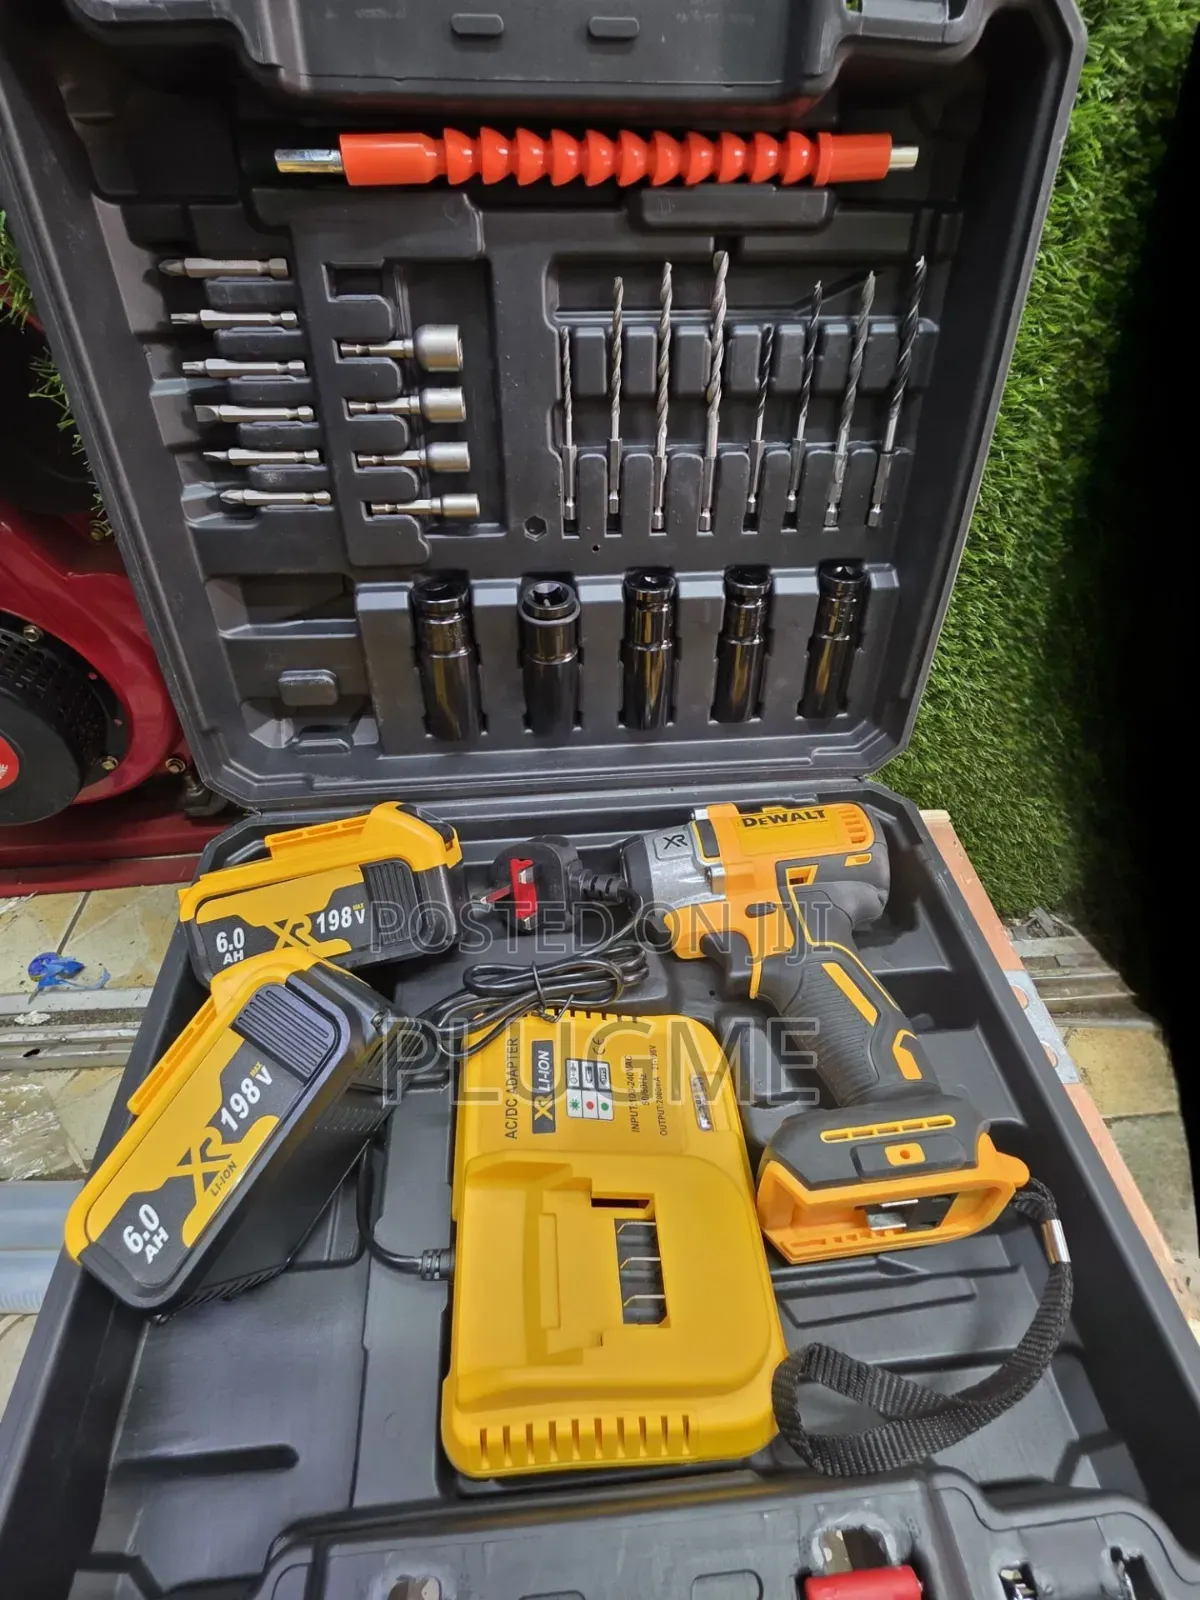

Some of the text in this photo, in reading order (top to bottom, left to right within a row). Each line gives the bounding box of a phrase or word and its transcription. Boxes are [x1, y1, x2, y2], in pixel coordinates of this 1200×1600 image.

[663, 834, 688, 850] XR
[265, 914, 320, 950] XR
[317, 906, 366, 934] 198 V
[216, 927, 245, 953] 6.0
[223, 950, 245, 966] AH
[220, 1065, 273, 1132] 198 V
[504, 1038, 518, 1140] AC/DC ADAPTER
[533, 1050, 553, 1121] XR LI-ION
[174, 1127, 234, 1200] XR
[210, 1160, 238, 1197] LI-ION
[123, 1203, 160, 1254] 6.0
[144, 1226, 170, 1264] AH
